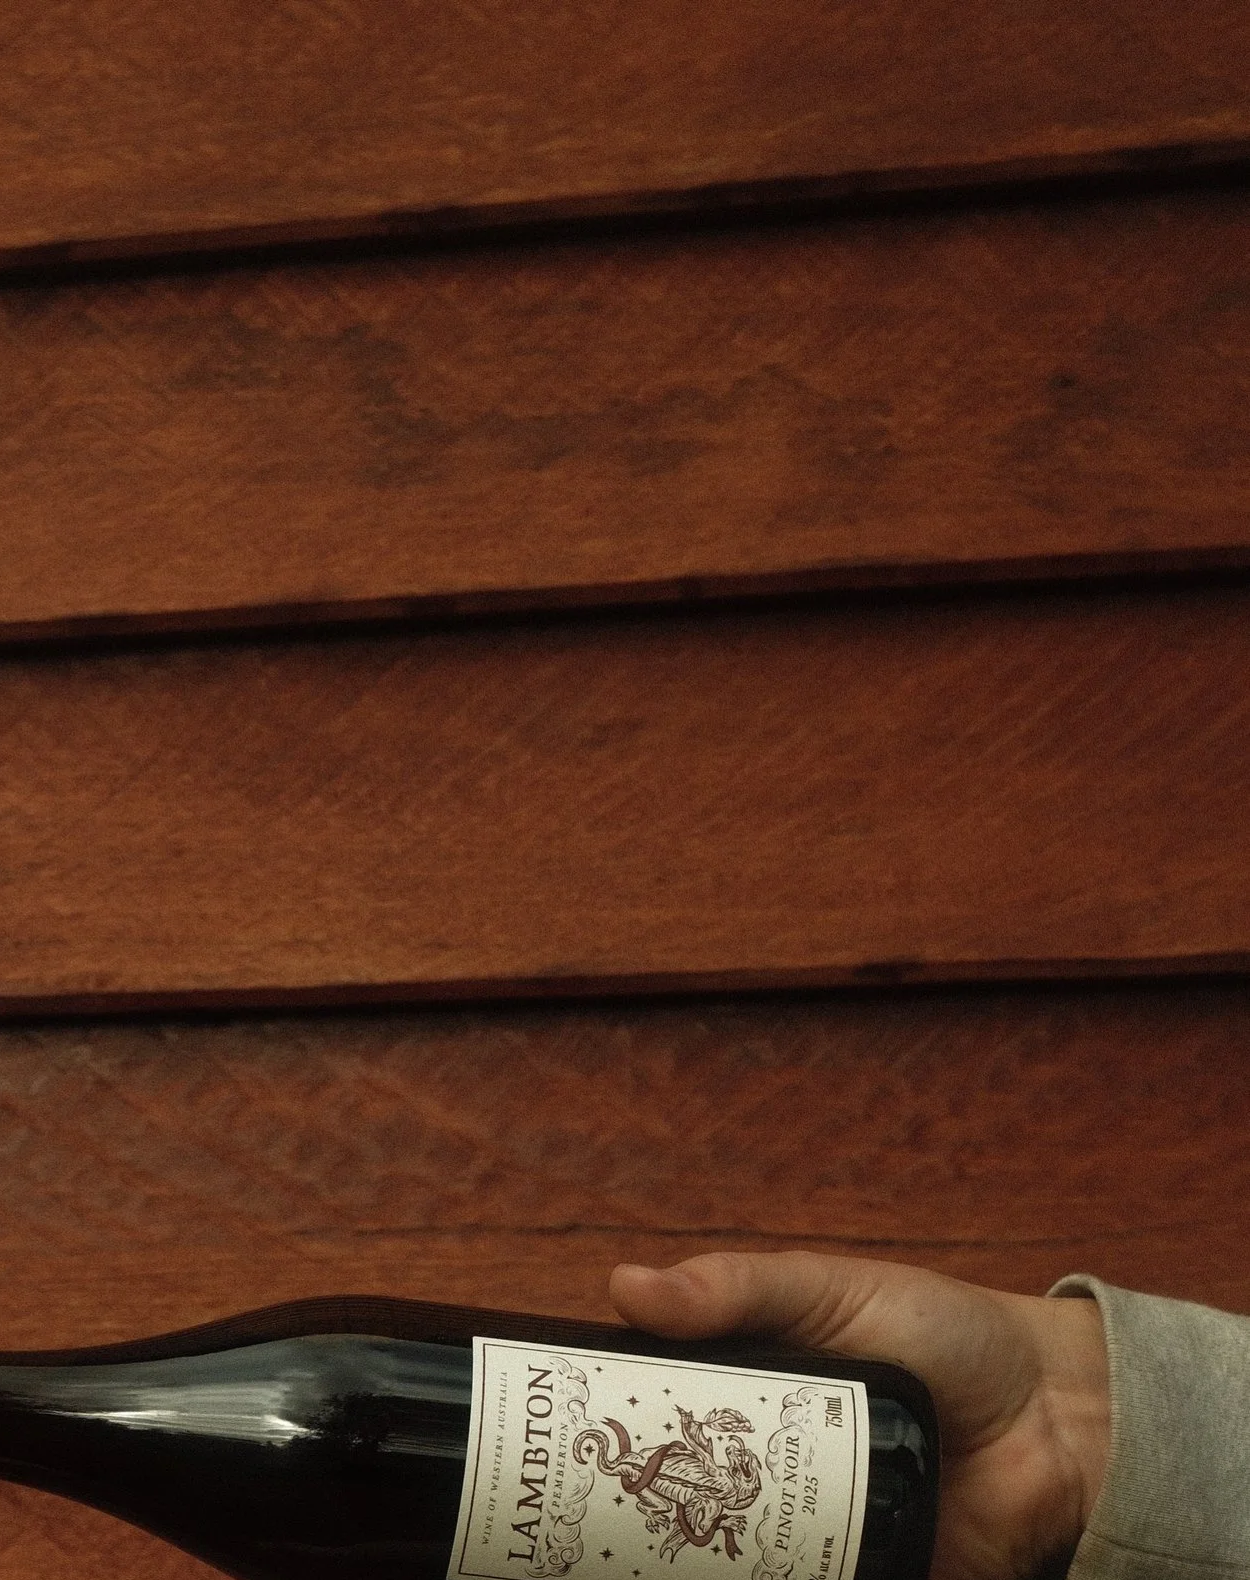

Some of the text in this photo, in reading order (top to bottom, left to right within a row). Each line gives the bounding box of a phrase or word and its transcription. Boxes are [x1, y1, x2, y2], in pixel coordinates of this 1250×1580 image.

[482, 1372, 508, 1545] WINE OF WESTERN AUSTRALIA
[507, 1364, 554, 1563] LAMBTON
[552, 1423, 569, 1508] PEMBERTON
[775, 1436, 799, 1552] PINOT NOIR
[802, 1475, 819, 1516] 2025
